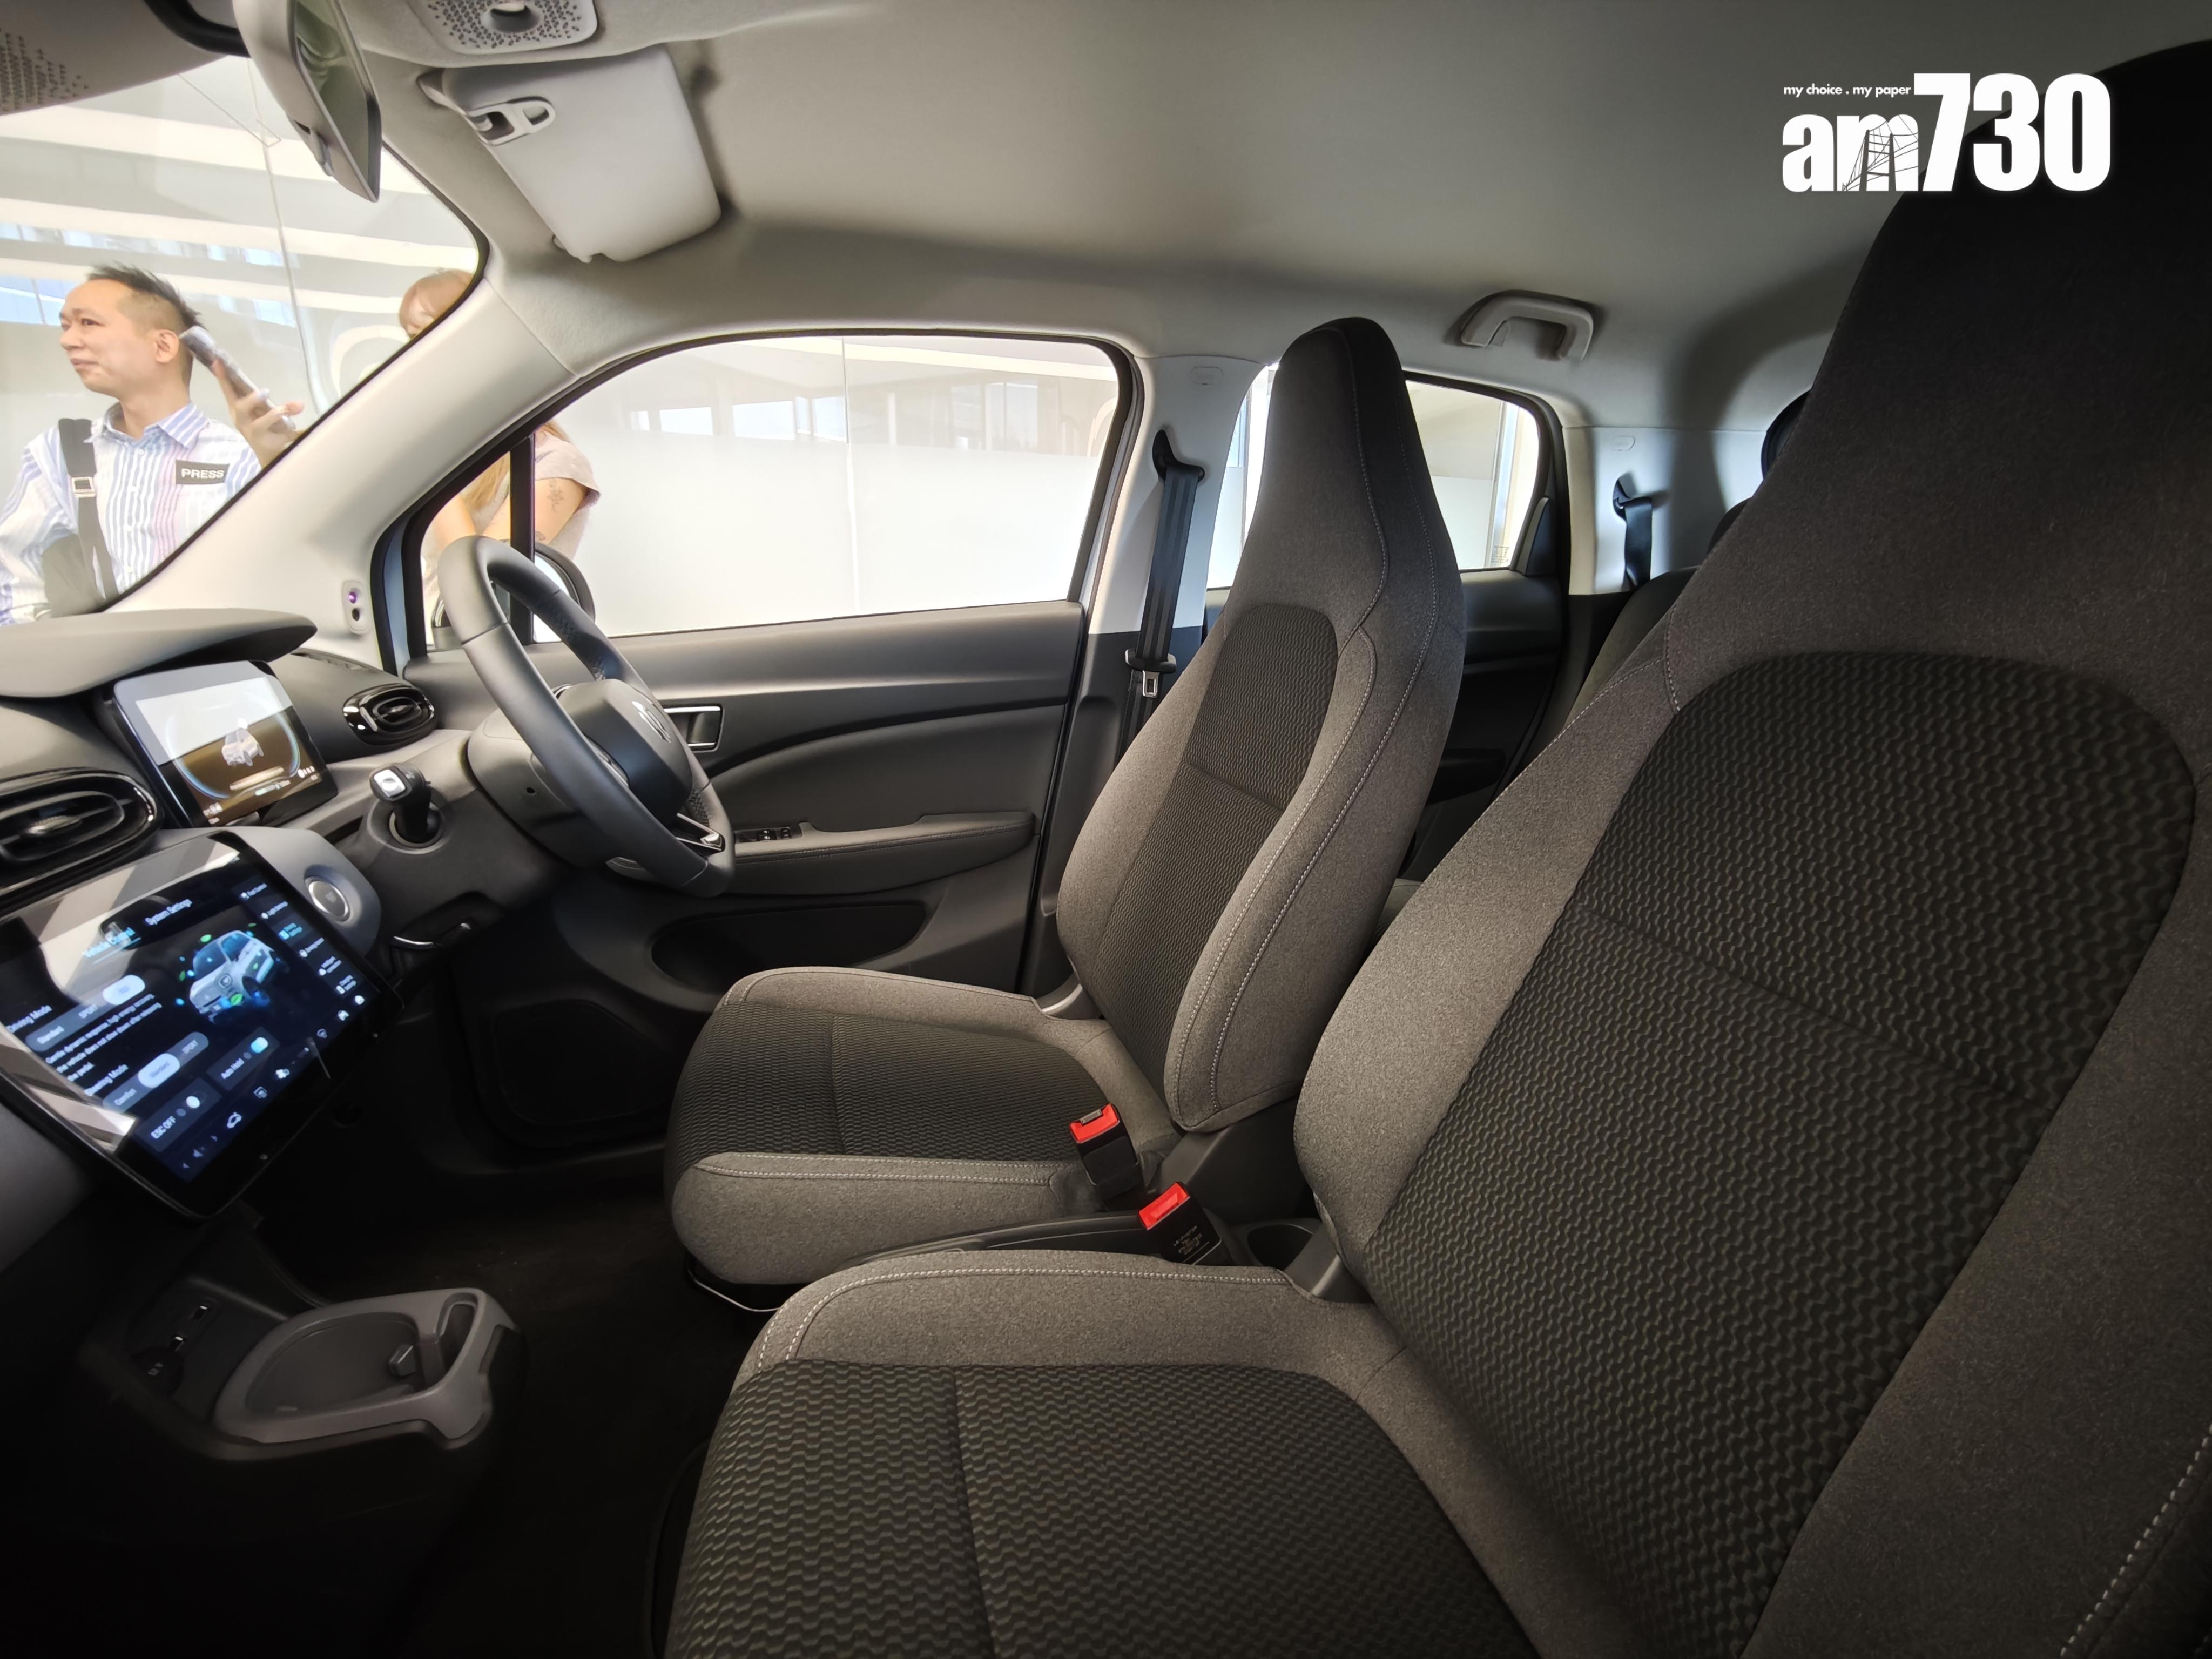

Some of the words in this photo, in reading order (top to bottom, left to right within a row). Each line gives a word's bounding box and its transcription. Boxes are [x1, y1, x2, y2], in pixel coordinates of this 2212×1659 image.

[181, 468, 225, 480] PRESS
[145, 909, 171, 925] System
[166, 899, 193, 914] Settings
[30, 1004, 52, 1020] Mode
[108, 1064, 129, 1080] Mode
[150, 1125, 166, 1139] ESC
[162, 1115, 176, 1129] OFF
